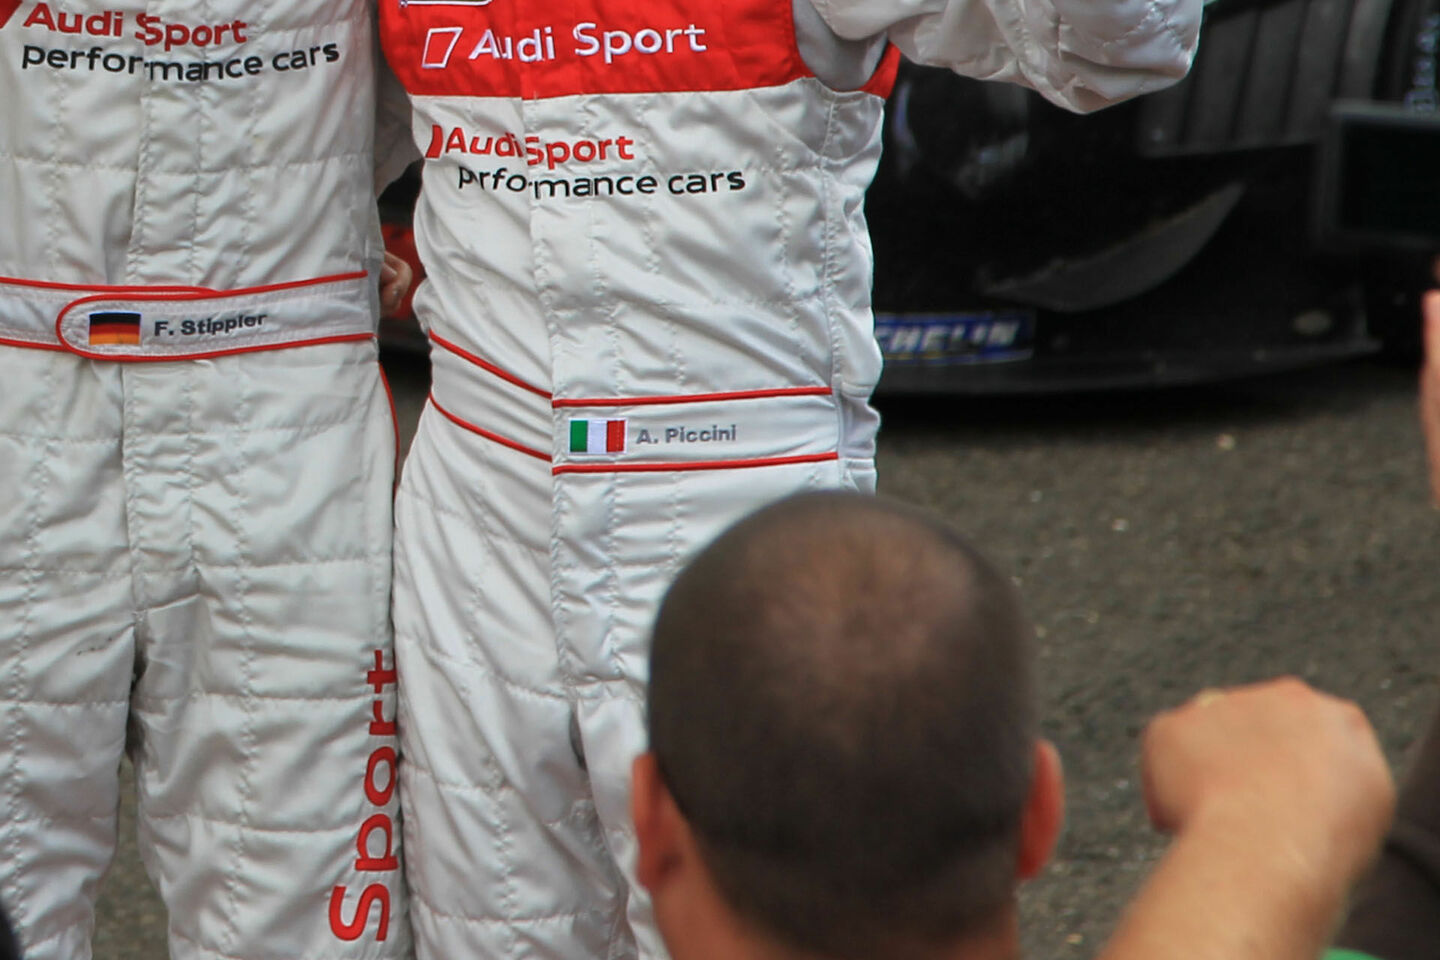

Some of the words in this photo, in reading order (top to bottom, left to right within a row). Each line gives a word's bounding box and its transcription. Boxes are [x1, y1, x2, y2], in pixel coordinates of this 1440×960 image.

[23, 2, 124, 38] Audi
[134, 12, 248, 52] Sport
[468, 26, 555, 63] Audi
[573, 22, 708, 64] Sport
[21, 44, 261, 82] performance
[272, 41, 340, 72] cars
[445, 127, 524, 159] Audi
[526, 135, 635, 171] Sport
[458, 165, 659, 199] prfomance
[667, 170, 746, 195] cars
[155, 320, 174, 337] F.
[181, 312, 267, 337] Stippler
[636, 429, 659, 444] A.
[665, 424, 737, 444] Piccini
[328, 650, 399, 941] Sport
